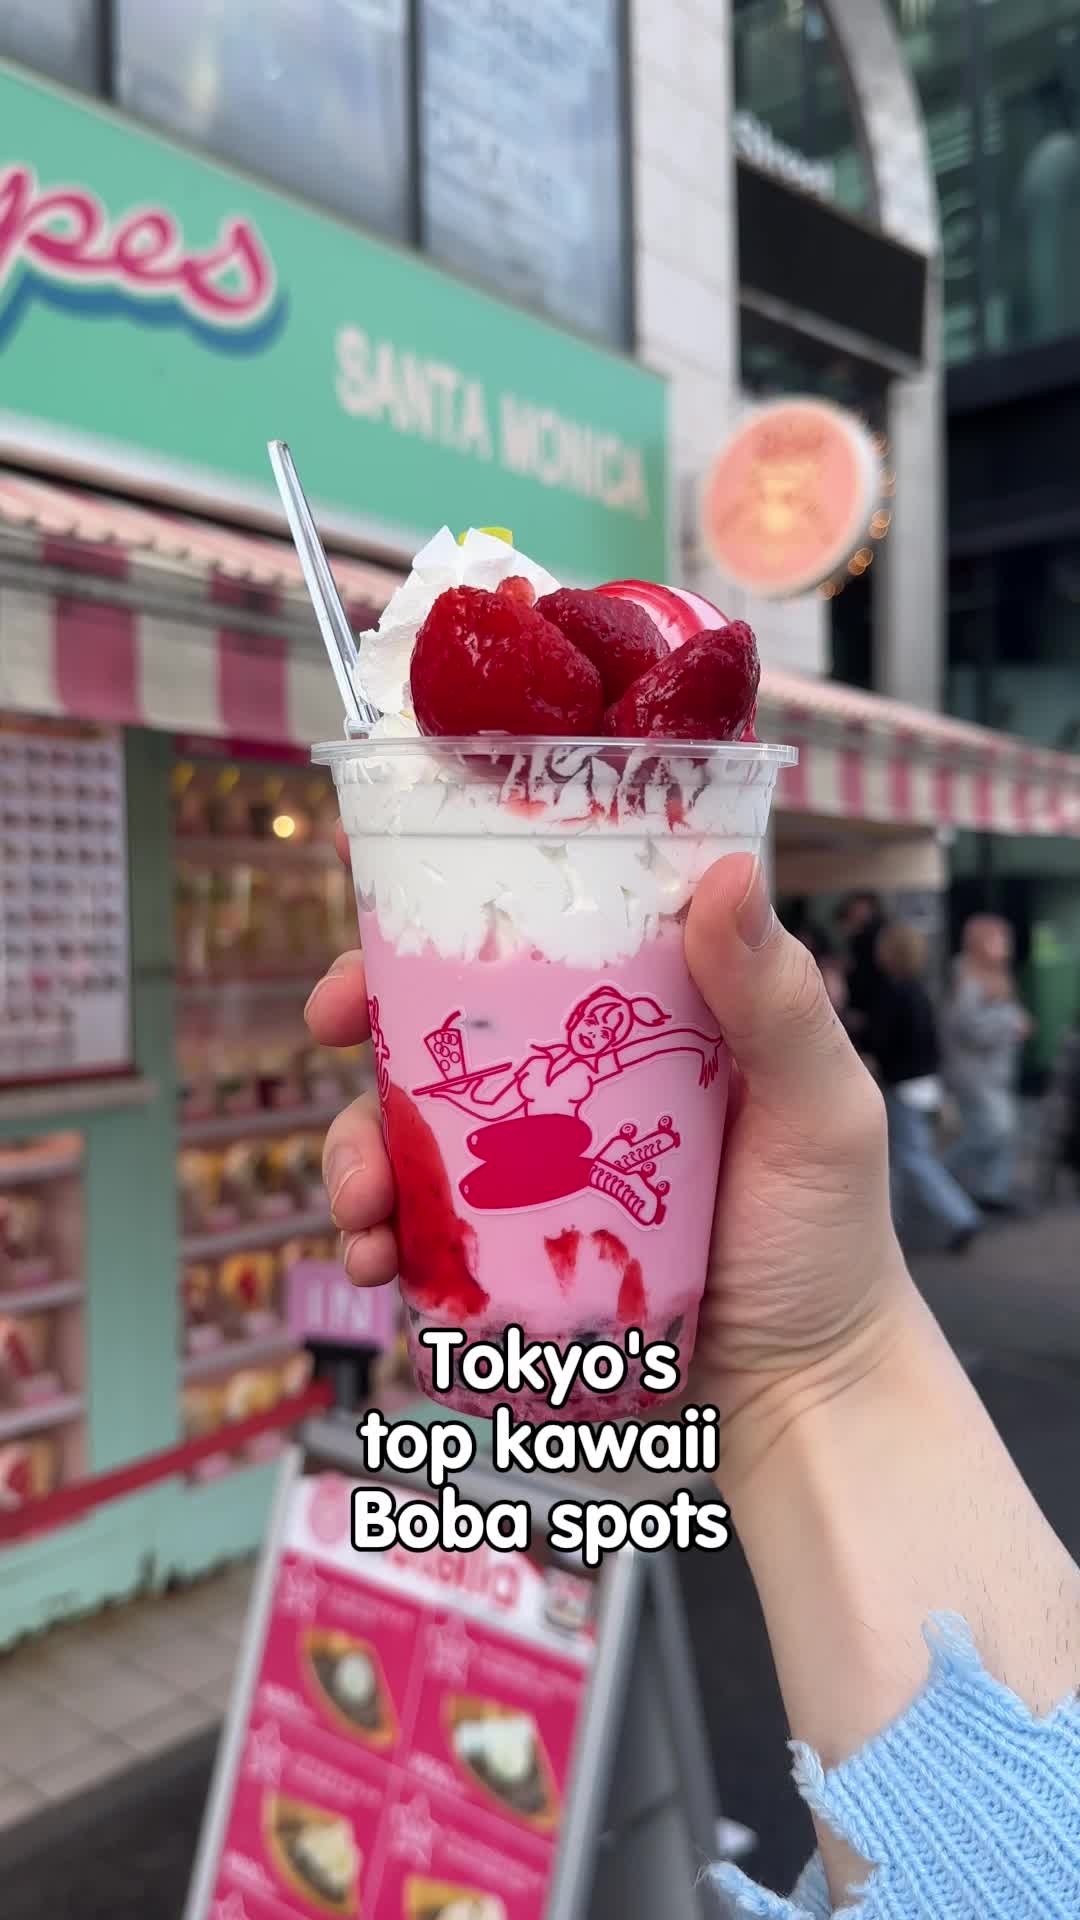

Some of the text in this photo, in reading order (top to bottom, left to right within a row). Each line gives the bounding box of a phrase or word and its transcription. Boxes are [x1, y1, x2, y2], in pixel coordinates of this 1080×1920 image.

[335, 323, 651, 520] SANTA MONICA
[305, 1281, 371, 1331] IN
